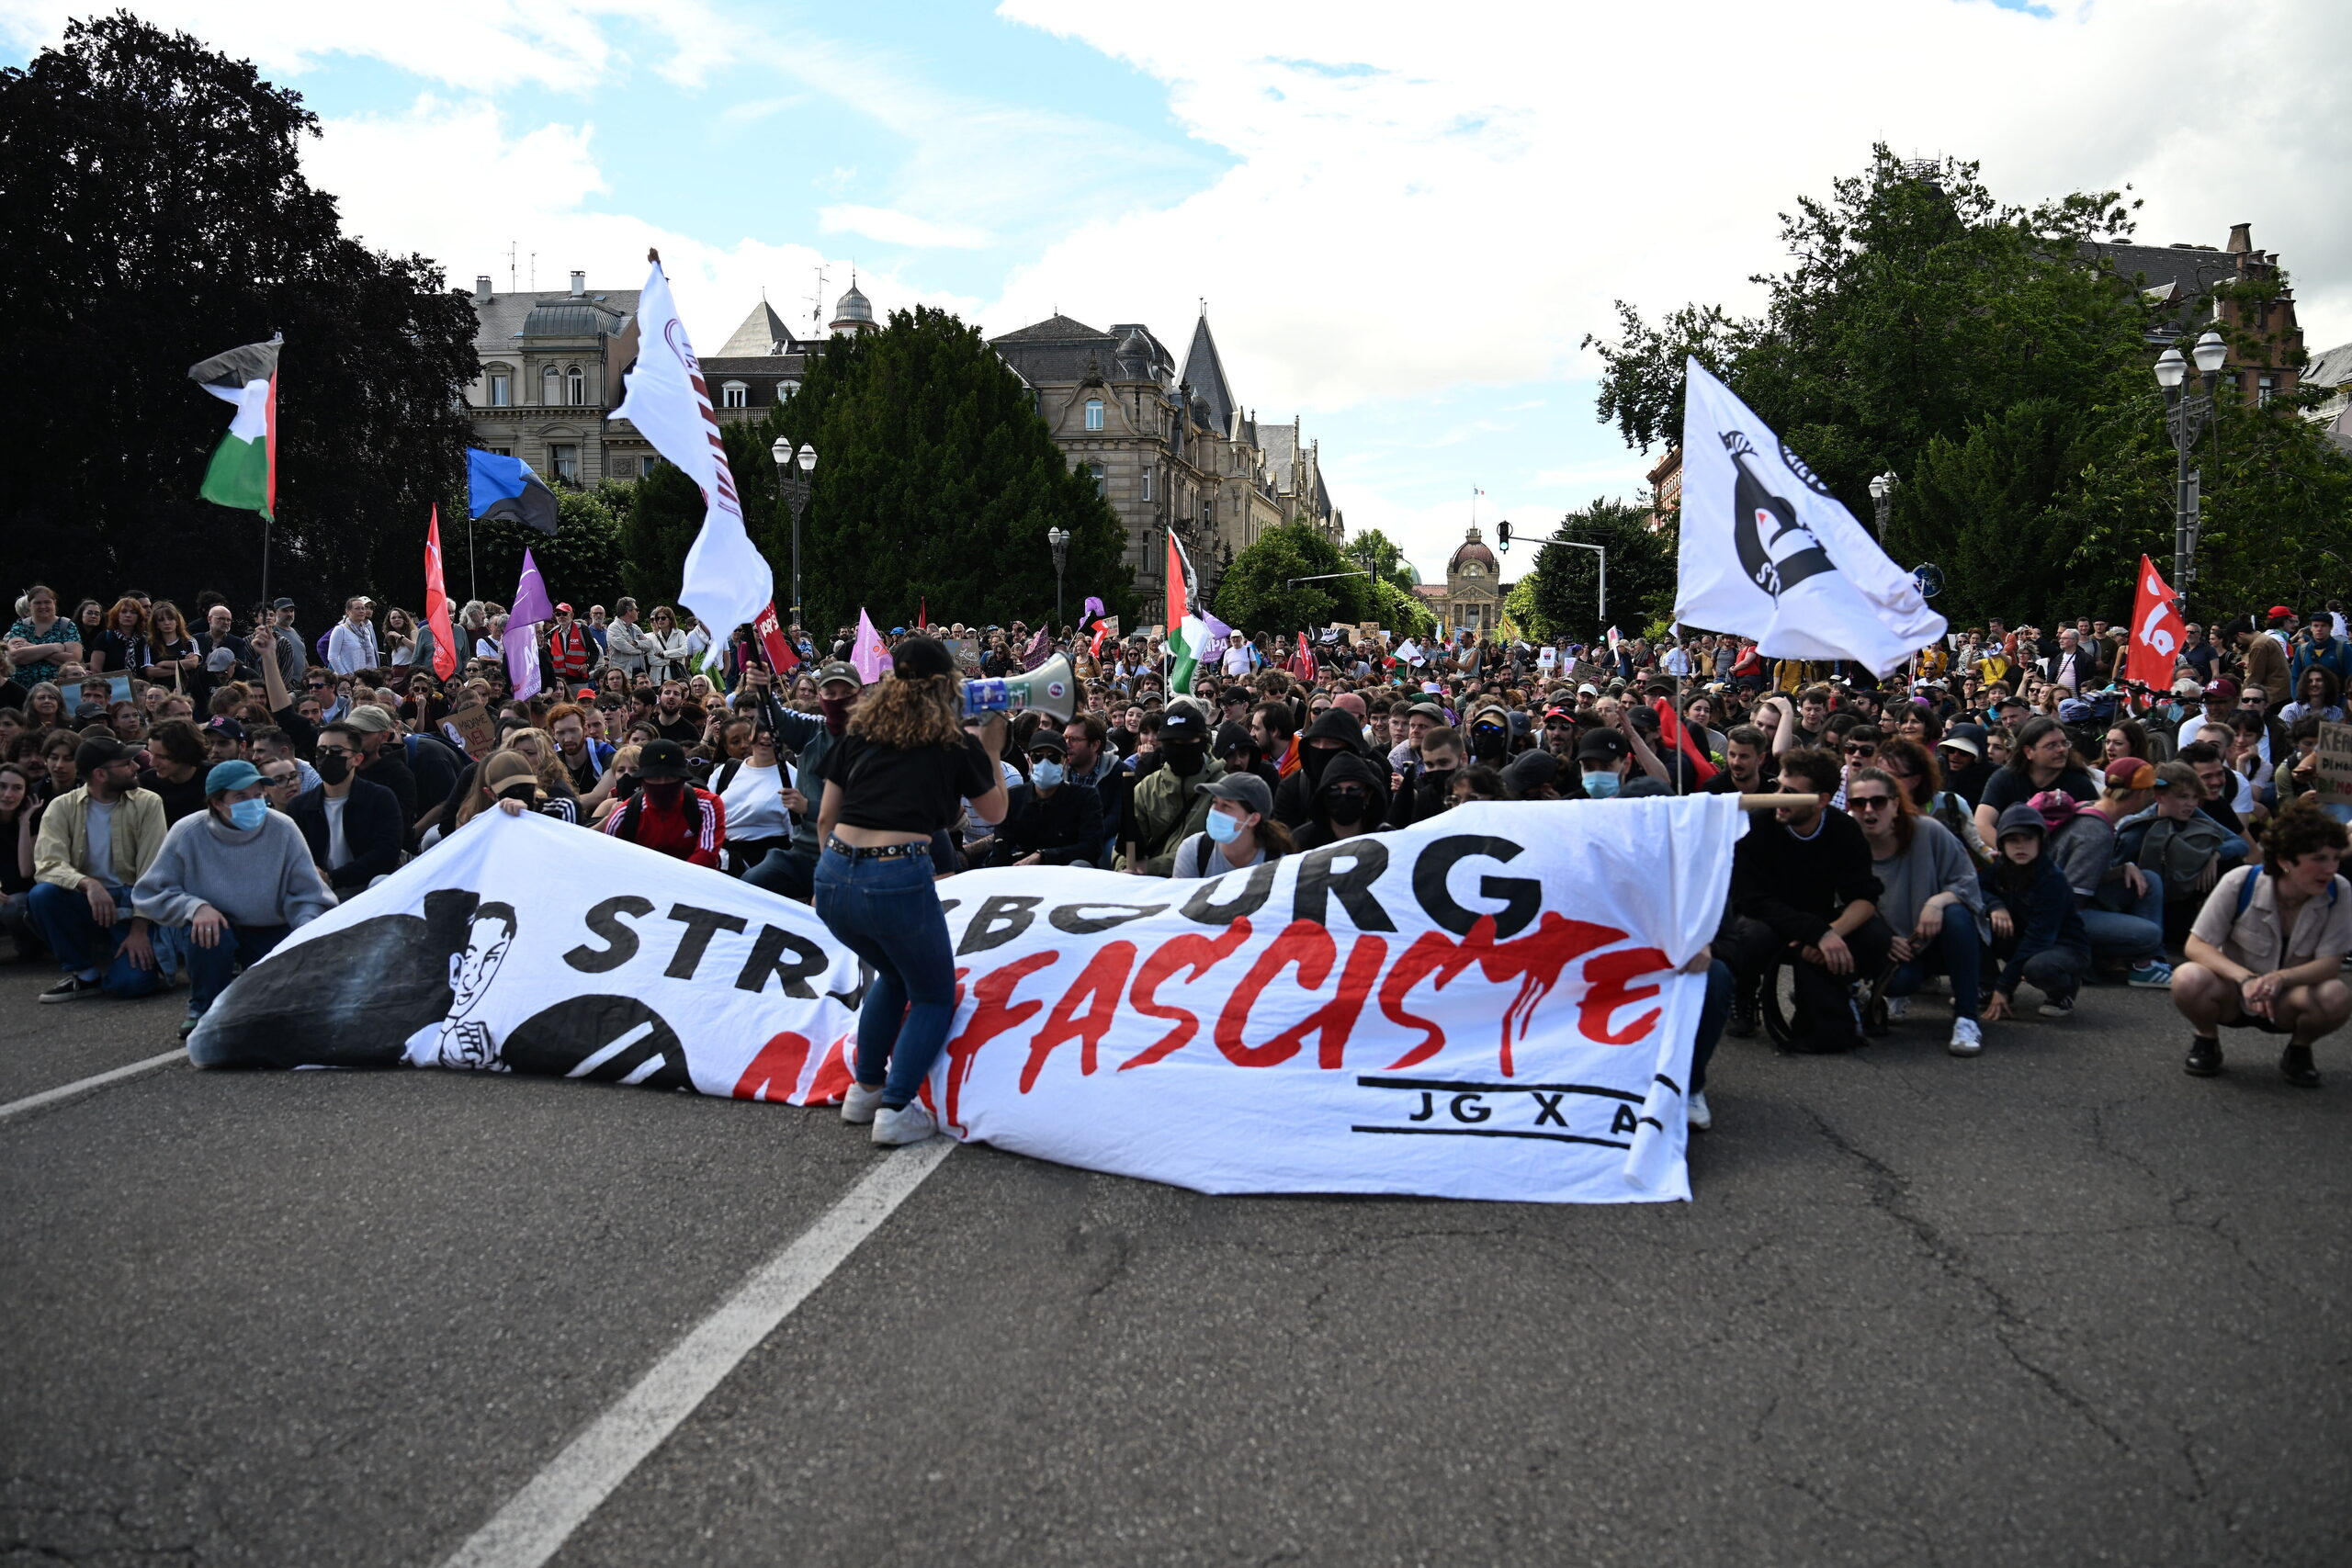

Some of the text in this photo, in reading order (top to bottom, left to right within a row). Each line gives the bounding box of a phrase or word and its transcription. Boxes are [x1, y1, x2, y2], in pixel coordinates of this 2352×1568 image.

[458, 713, 488, 730] MADAME
[466, 728, 494, 745] VEIL
[562, 834, 1542, 1010] STRBOURG
